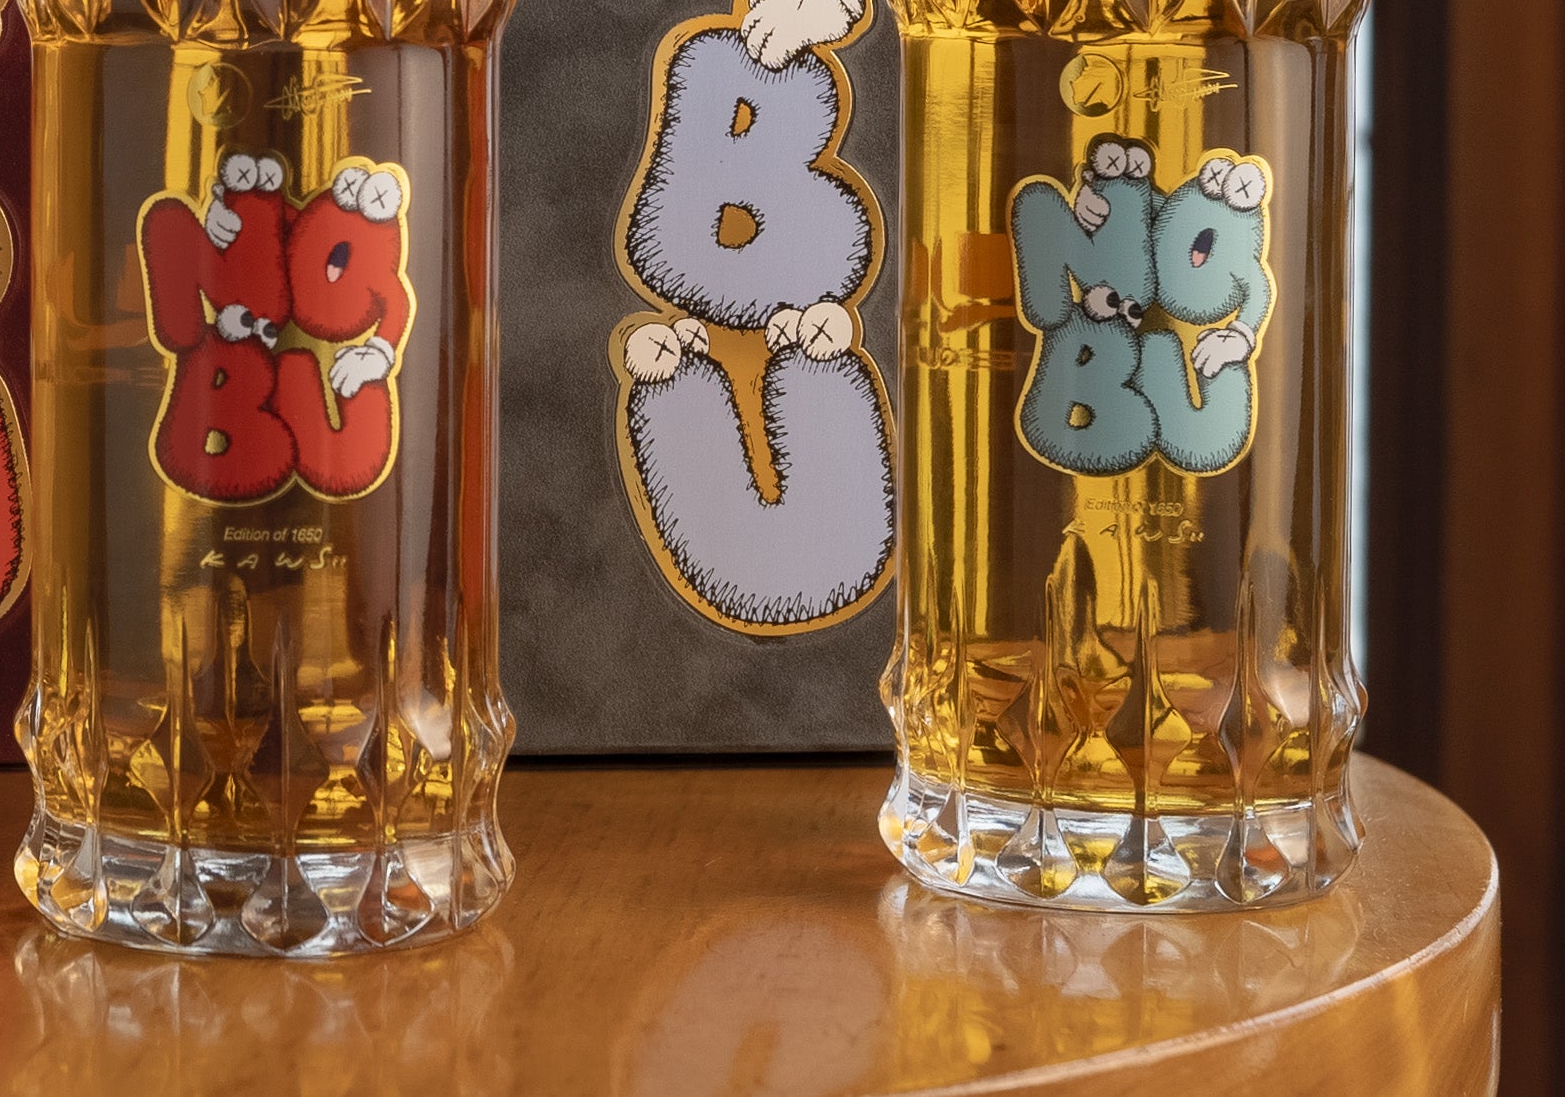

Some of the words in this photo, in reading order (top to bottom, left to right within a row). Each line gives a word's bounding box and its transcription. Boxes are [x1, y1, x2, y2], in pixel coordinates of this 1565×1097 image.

[223, 527, 270, 542] Edition
[272, 528, 287, 542] of
[292, 527, 323, 543] 1650
